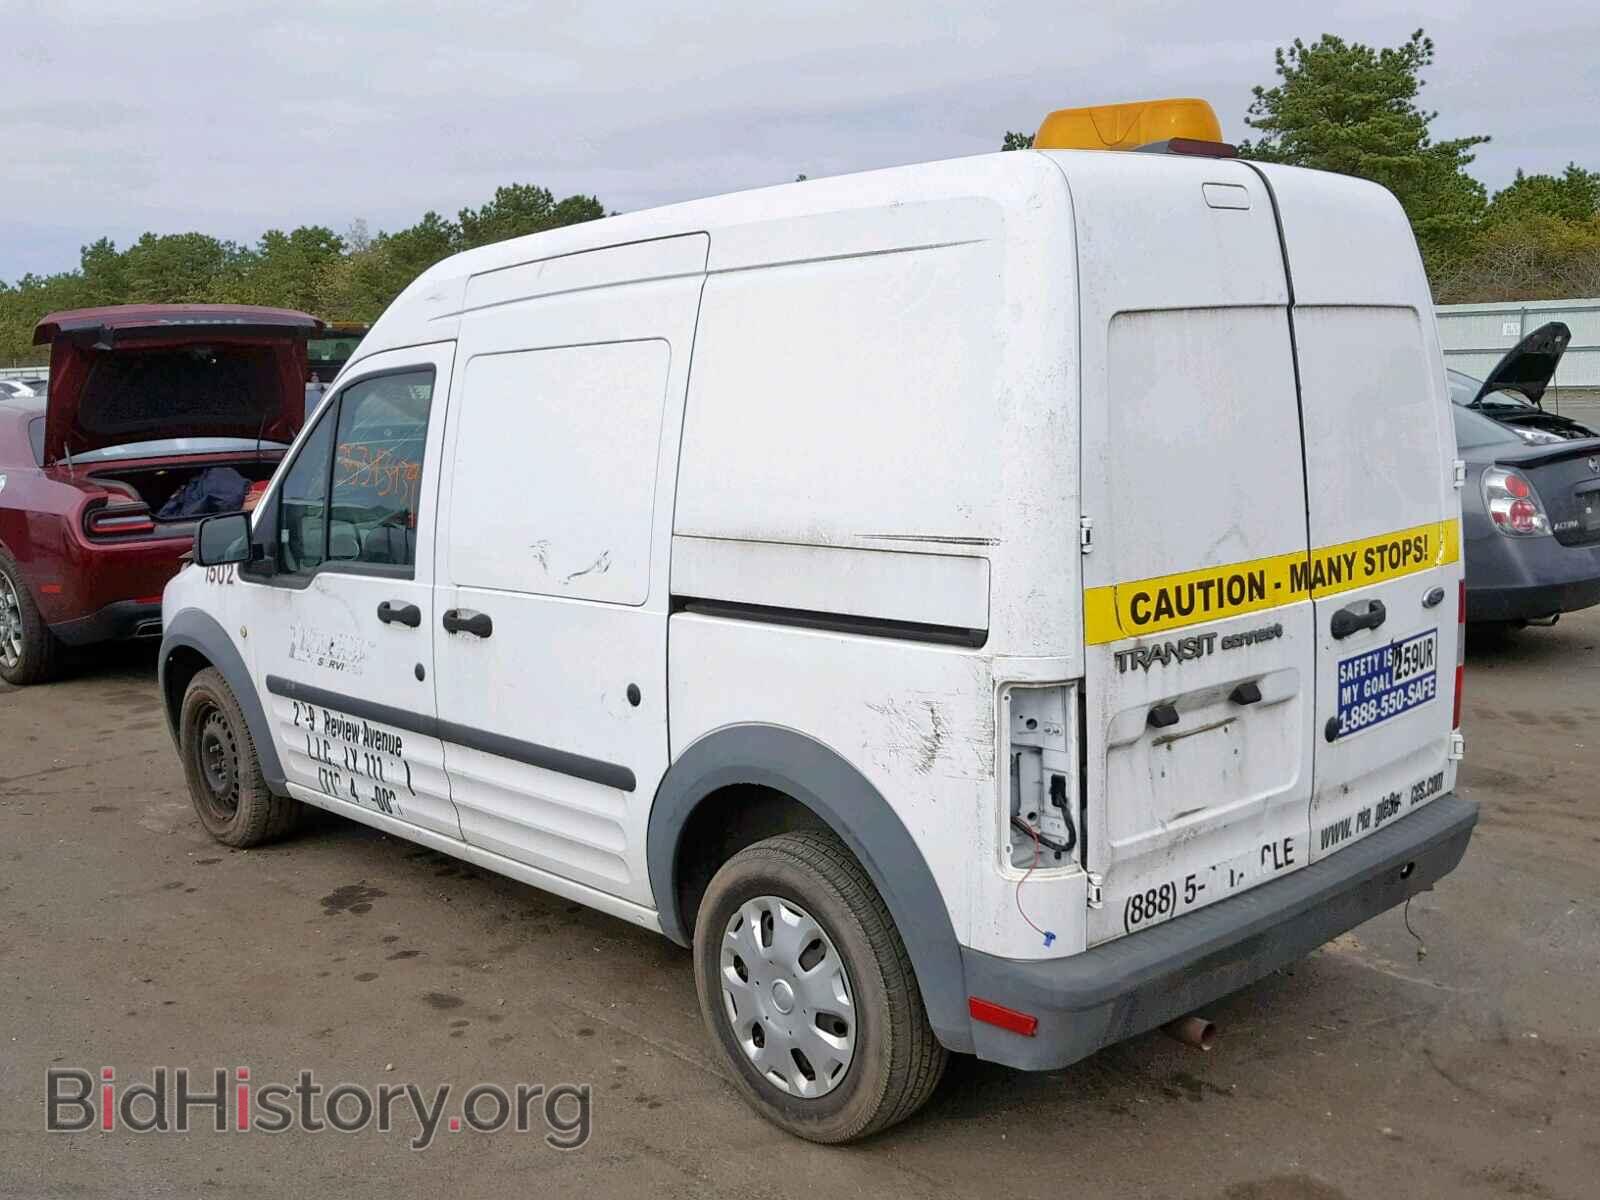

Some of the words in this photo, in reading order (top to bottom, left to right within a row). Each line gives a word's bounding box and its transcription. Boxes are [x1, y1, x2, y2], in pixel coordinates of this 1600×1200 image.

[1130, 570, 1266, 626] CAUTION
[1274, 582, 1282, 590] -
[1289, 551, 1357, 593] MANY
[1364, 534, 1428, 576] STOPS!
[1114, 631, 1218, 674] TRANSIT
[1221, 622, 1283, 650] connect
[1340, 652, 1380, 683] SAFETY
[1384, 647, 1393, 668] IS
[1339, 674, 1435, 734] 1-888-550-SAFE
[1342, 683, 1359, 706] MY
[1364, 672, 1391, 698] GOAL
[323, 709, 360, 744] Review
[362, 720, 403, 757] Avenue
[1124, 881, 1177, 934] (888)
